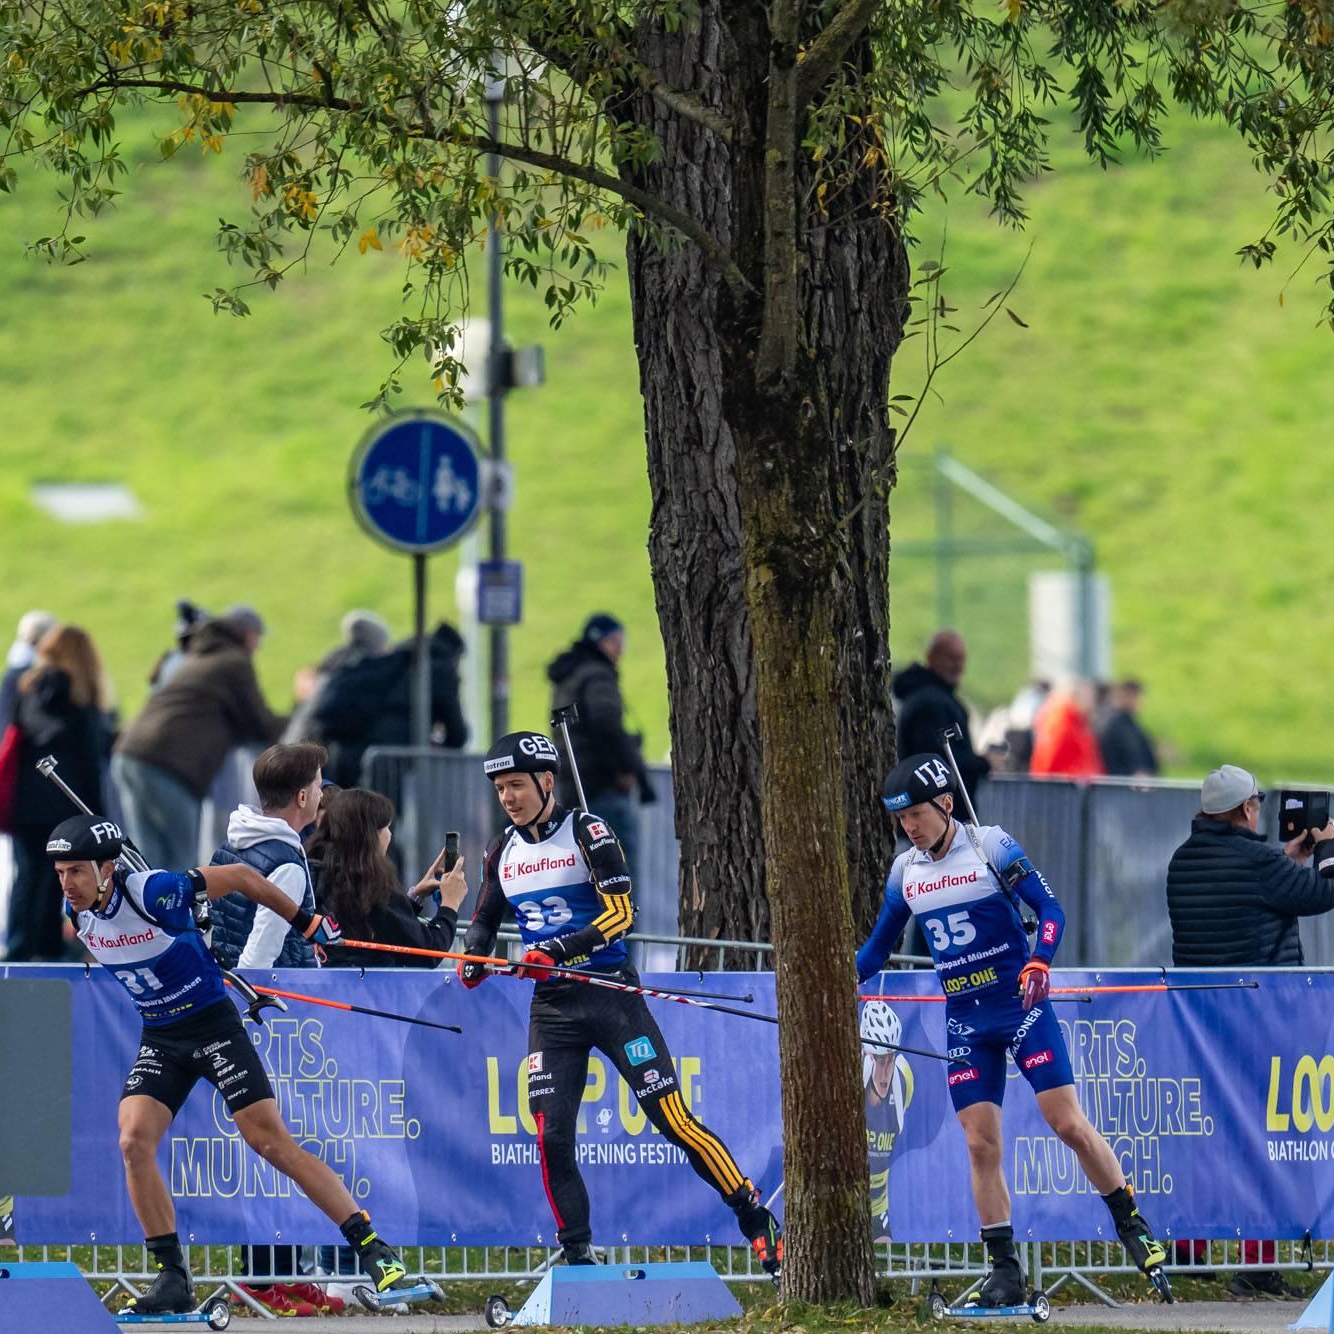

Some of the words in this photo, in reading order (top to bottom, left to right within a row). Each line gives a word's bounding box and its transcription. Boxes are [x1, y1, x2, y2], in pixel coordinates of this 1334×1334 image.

[914, 759, 950, 787] ITA
[517, 854, 576, 876] Kaufland
[918, 871, 978, 895] Kaufland
[517, 895, 573, 931] 33
[98, 928, 155, 949] Kaufland
[925, 910, 977, 951] 35
[967, 942, 1010, 963] München
[114, 967, 164, 995] 31
[970, 966, 998, 986] ONE
[243, 1018, 338, 1078] RTS.
[628, 1041, 651, 1058] TQ
[1025, 1052, 1049, 1068] enel
[636, 1076, 674, 1099] tectake
[949, 1069, 975, 1085] enel
[486, 1056, 607, 1136] LOP
[1075, 1078, 1214, 1137] ULTURE.
[491, 1143, 540, 1165] BIATHL
[639, 1143, 689, 1165] FESTIV
[1267, 1140, 1328, 1161] BIATHLON
